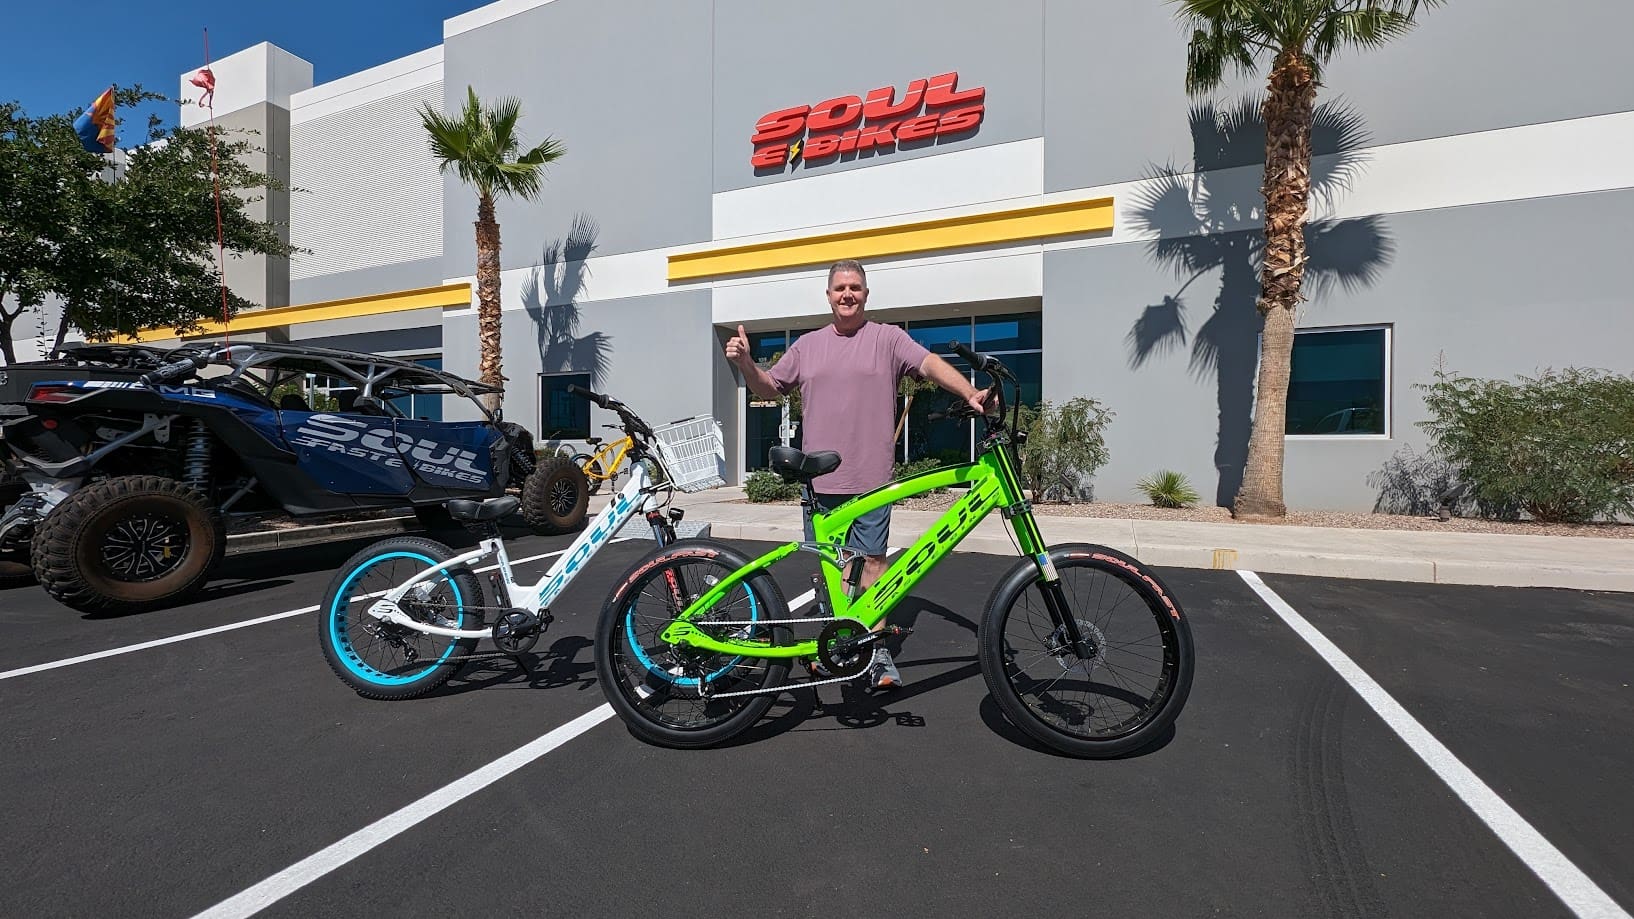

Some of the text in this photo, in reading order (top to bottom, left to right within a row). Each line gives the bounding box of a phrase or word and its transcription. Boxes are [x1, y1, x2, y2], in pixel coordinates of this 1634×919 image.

[751, 71, 985, 144] SOUL
[297, 414, 487, 476] SOUL
[539, 493, 640, 606] SOUL
[874, 486, 999, 610] SOUL
